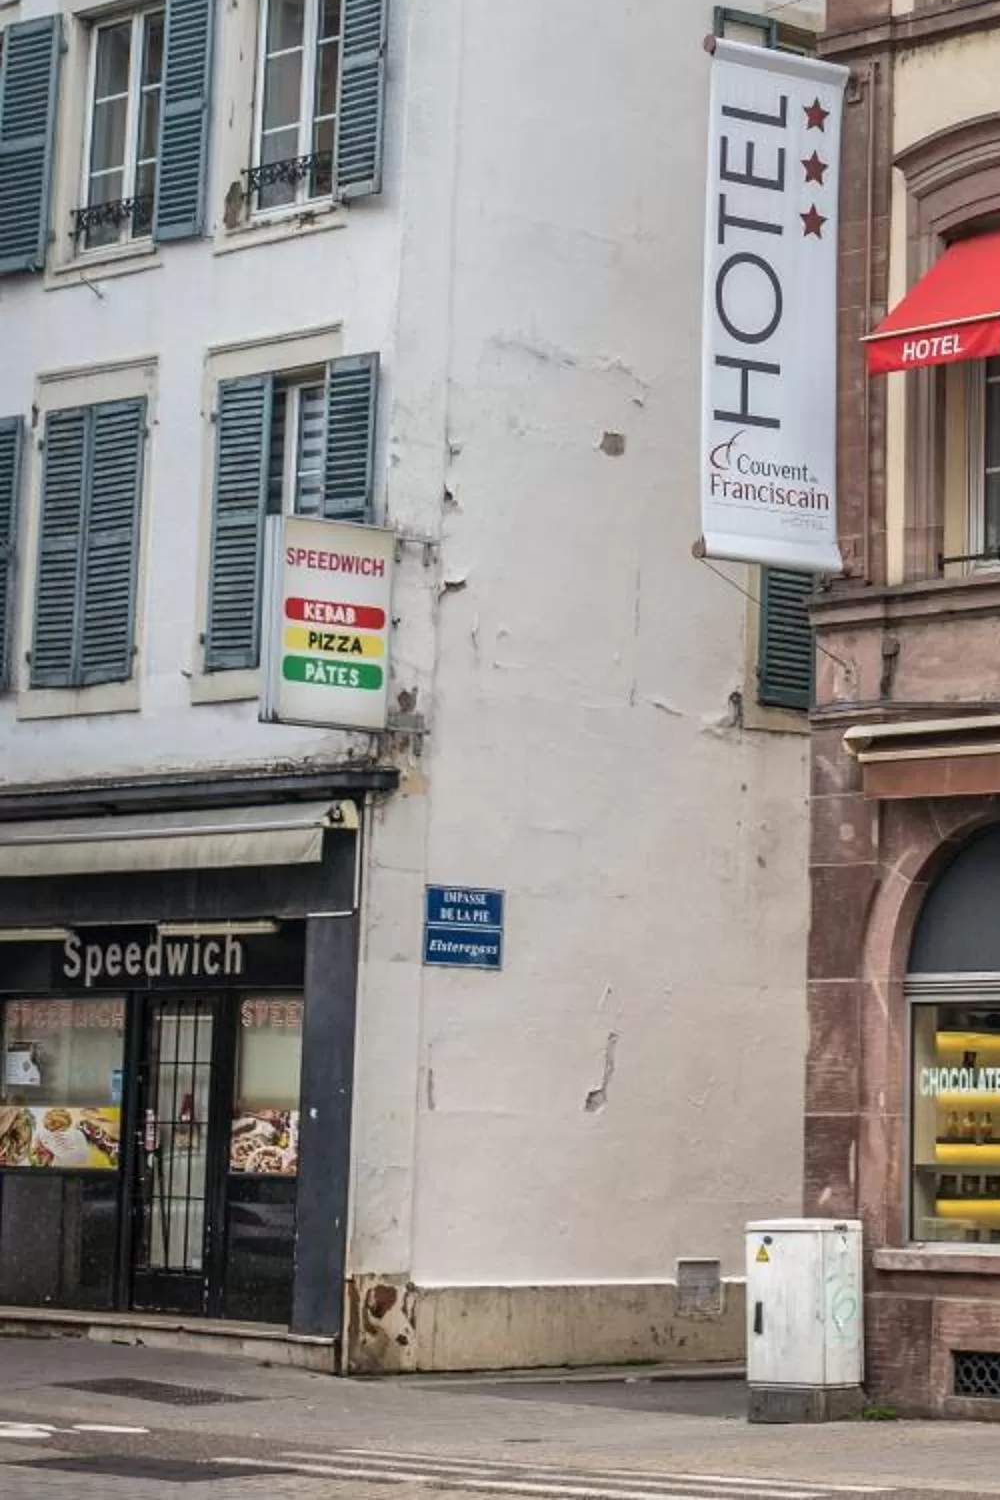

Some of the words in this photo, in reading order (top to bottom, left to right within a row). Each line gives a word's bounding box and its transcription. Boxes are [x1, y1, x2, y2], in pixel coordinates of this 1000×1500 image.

[713, 94, 788, 429] HOTEL
[901, 334, 966, 362] HOTEL
[737, 453, 808, 483] Couvent
[710, 473, 829, 511] Franciscain
[285, 547, 385, 577] SPEEDWICH
[303, 601, 357, 625] KEBAB
[308, 631, 363, 654] PIZZA
[305, 659, 360, 686] PÂTES
[443, 891, 488, 905] IMPASSE
[440, 907, 455, 920] DE
[456, 909, 471, 921] LA
[473, 909, 491, 923] PIE
[62, 931, 244, 987] Speedwich
